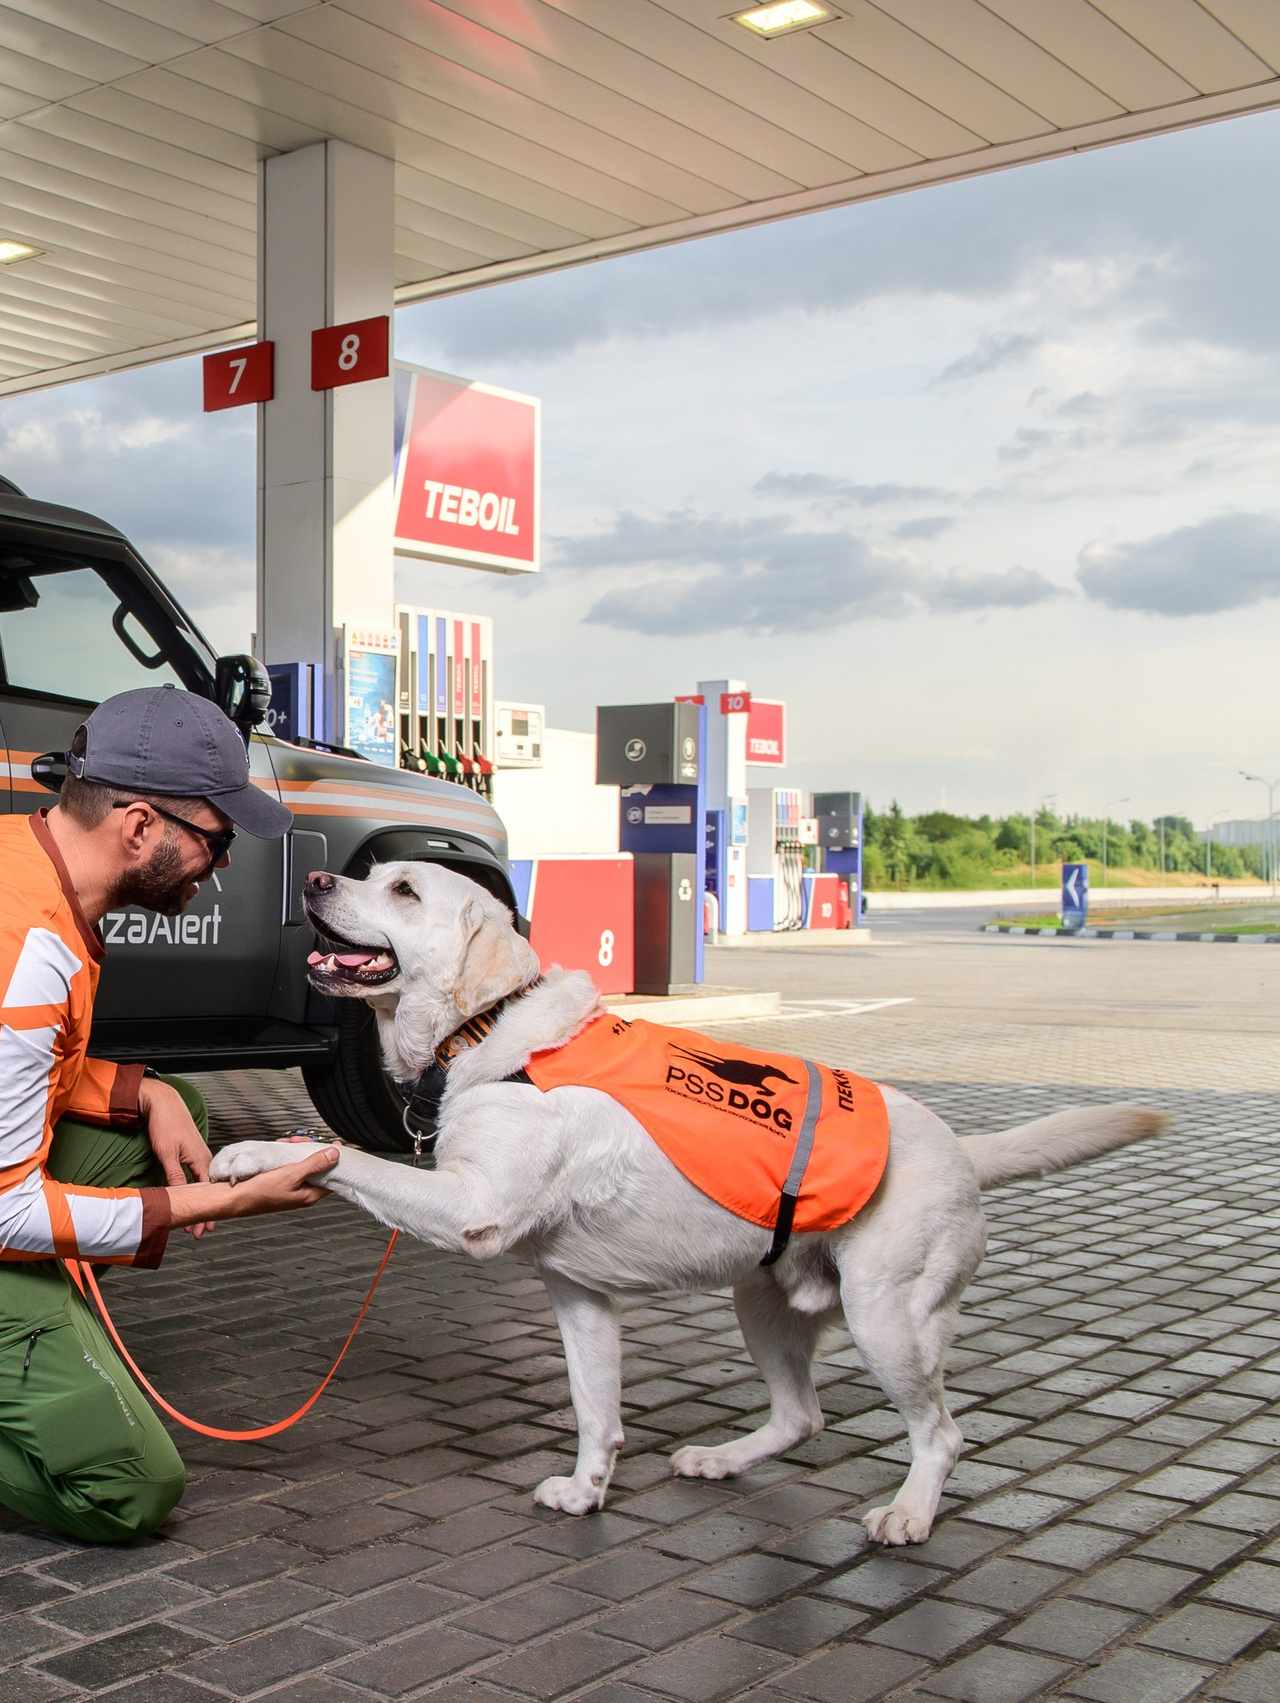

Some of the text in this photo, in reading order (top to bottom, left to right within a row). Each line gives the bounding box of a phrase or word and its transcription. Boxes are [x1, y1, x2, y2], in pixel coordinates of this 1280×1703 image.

[338, 333, 361, 371] 8
[228, 357, 248, 395] 7
[424, 479, 520, 536] TEBOIL
[726, 696, 744, 710] 10
[749, 737, 780, 756] TEBOIL
[98, 903, 222, 945] zaAlert
[598, 929, 615, 967] 8
[831, 1069, 855, 1113] ПЕКК
[83, 1349, 136, 1427] FINNTRAIL
